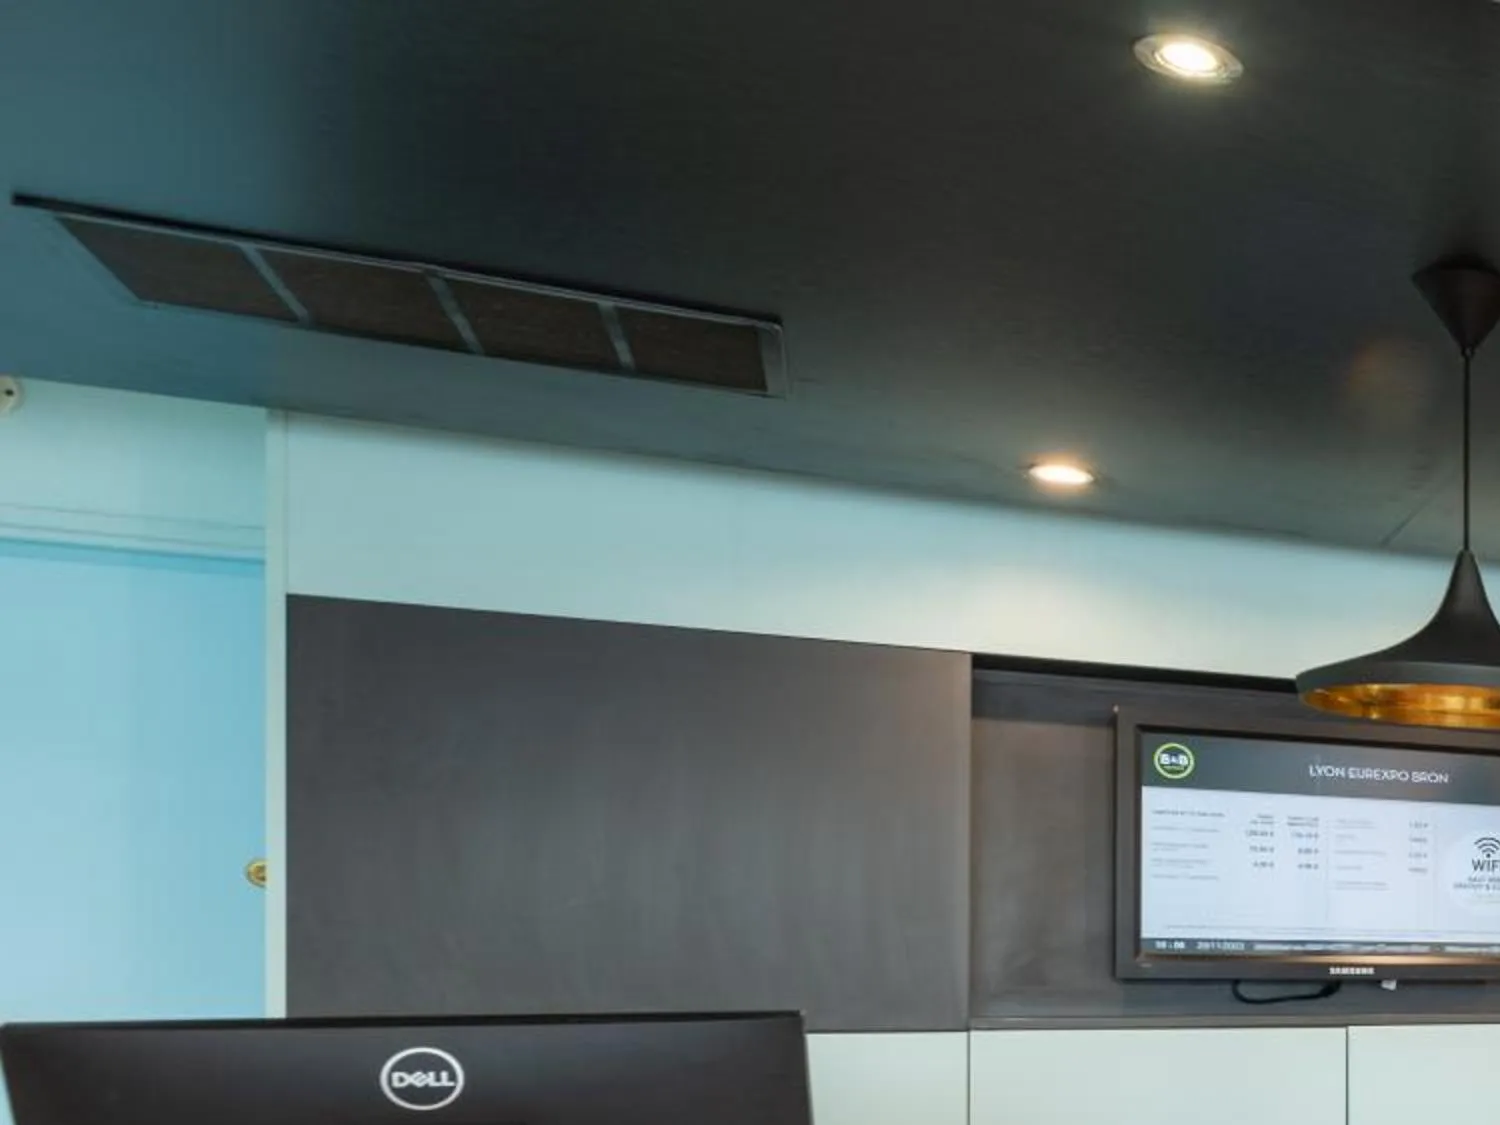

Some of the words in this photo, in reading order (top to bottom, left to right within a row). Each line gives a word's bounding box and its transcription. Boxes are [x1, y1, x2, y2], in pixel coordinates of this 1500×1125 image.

[1309, 764, 1345, 778] LYON
[1347, 766, 1409, 781] EUREXPO
[1411, 770, 1449, 783] BRON
[391, 1069, 456, 1089] DELL
